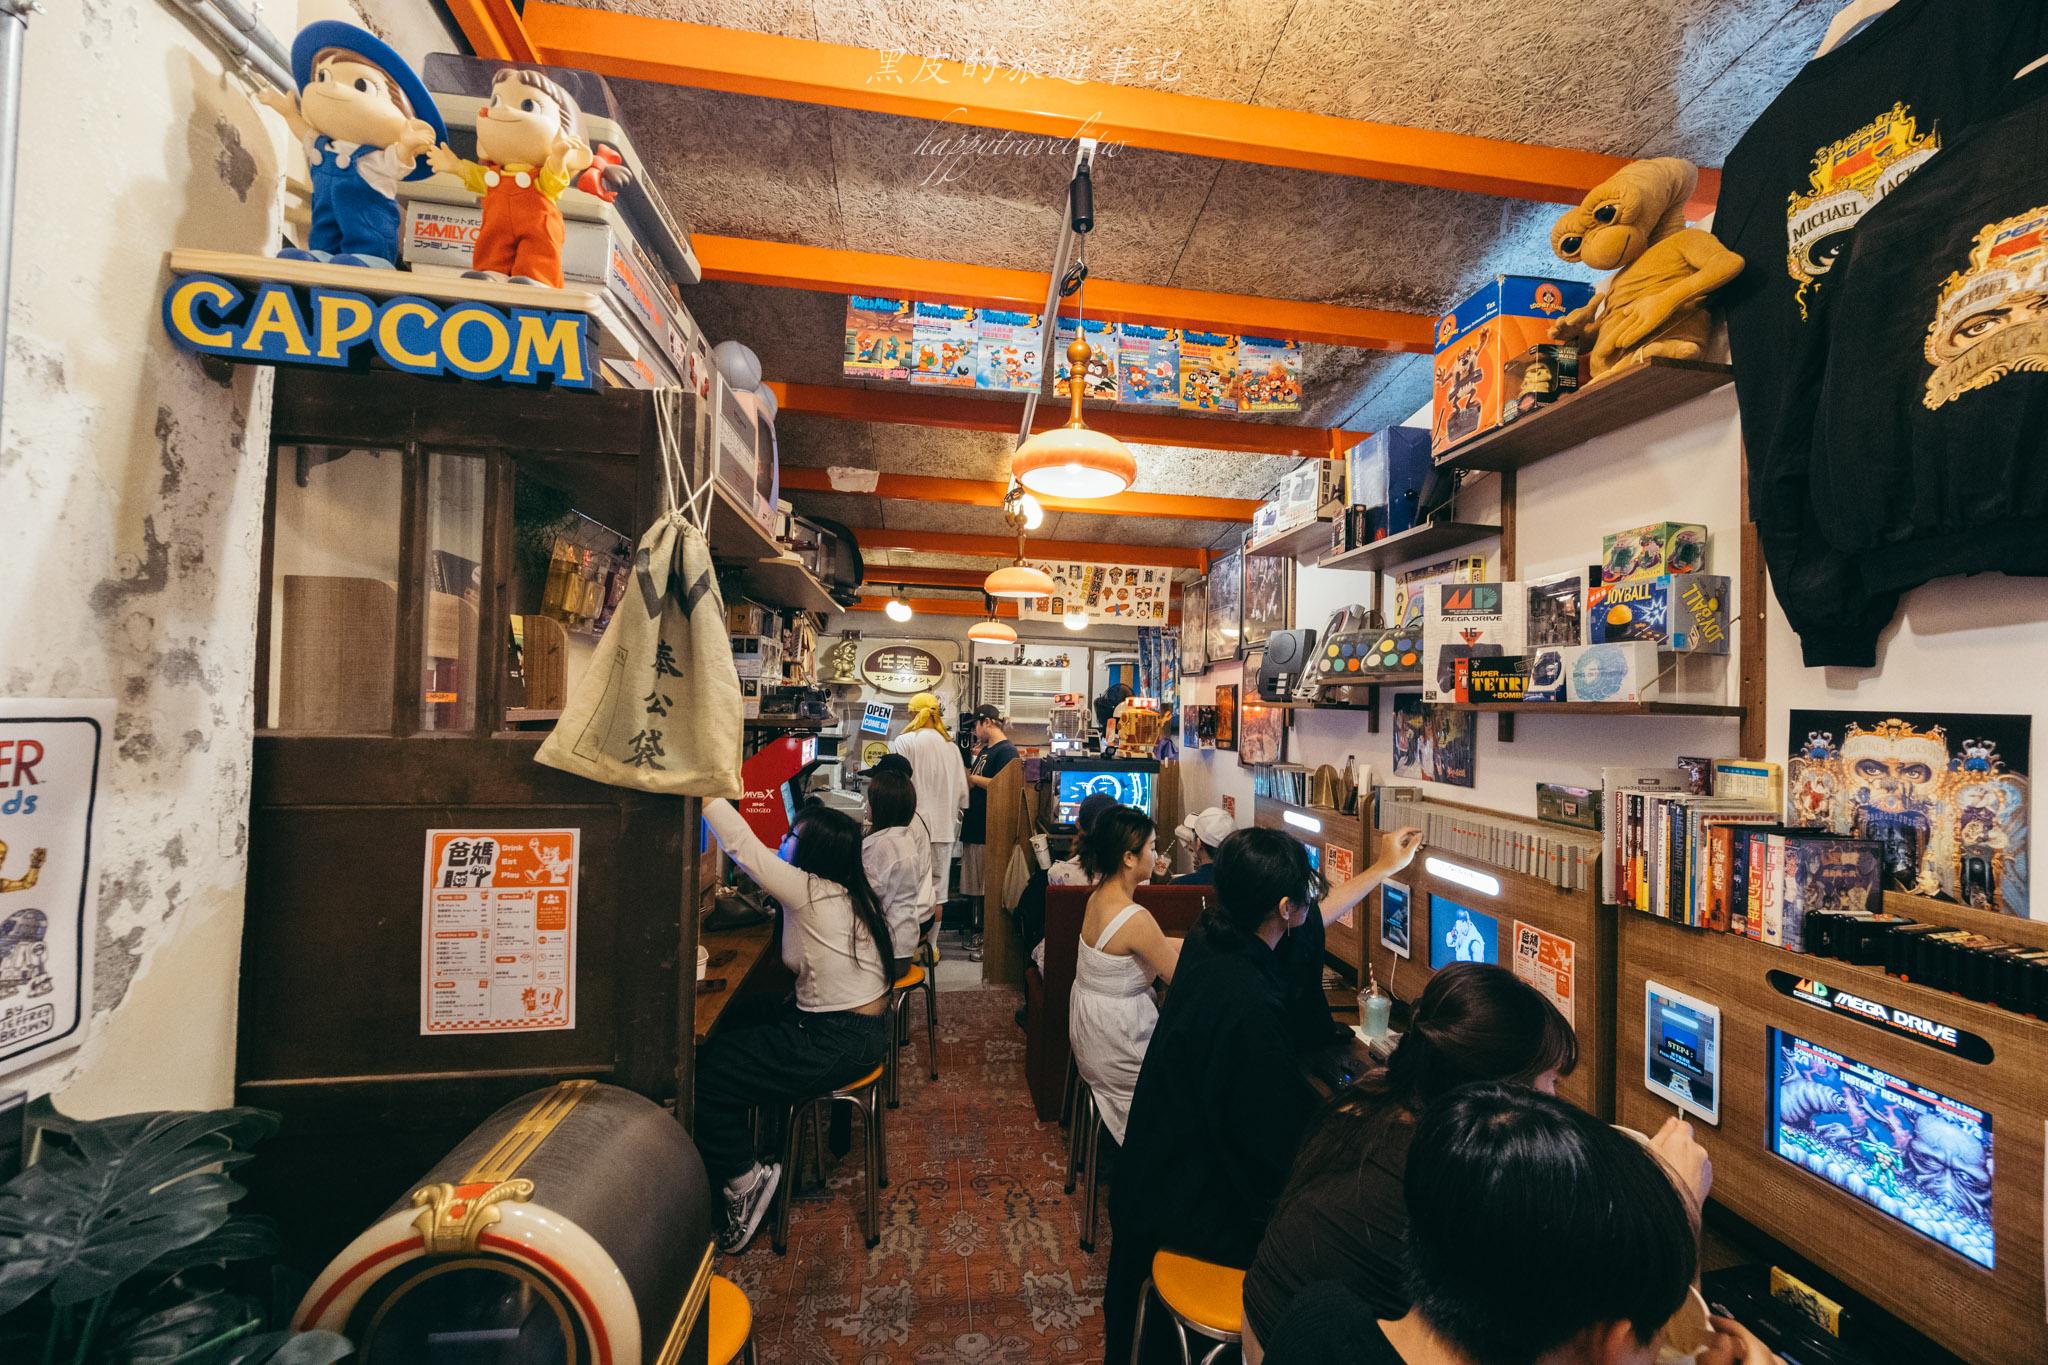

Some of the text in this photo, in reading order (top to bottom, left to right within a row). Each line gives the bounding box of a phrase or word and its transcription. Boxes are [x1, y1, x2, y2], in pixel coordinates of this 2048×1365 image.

[1832, 123, 1892, 167] PEPSI
[414, 221, 470, 240] FAMILY
[1792, 201, 1863, 243] MICHAEL
[170, 279, 585, 383] CAPCOM
[1603, 583, 1652, 605] JOYBALL
[1681, 583, 1725, 644] JOYBALL
[877, 653, 930, 672] 任天堂
[622, 639, 684, 771] 奉公袋
[866, 703, 891, 719] OPEN
[864, 718, 880, 728] COME
[448, 841, 494, 867] 爸媽
[1794, 977, 1828, 997] MD
[0, 1018, 50, 1042] BROWN
[1834, 991, 1889, 1021] MEGA
[1893, 1010, 1958, 1044] DRIVE
[1794, 1047, 1839, 1070] DONATELLO
[1794, 1038, 1810, 1049] 1UP
[1856, 1062, 1870, 1073] HI
[1917, 1087, 1938, 1100] 2UP
[1840, 1071, 1880, 1098] INSTANT
[1880, 1085, 1917, 1111] REPLAY
